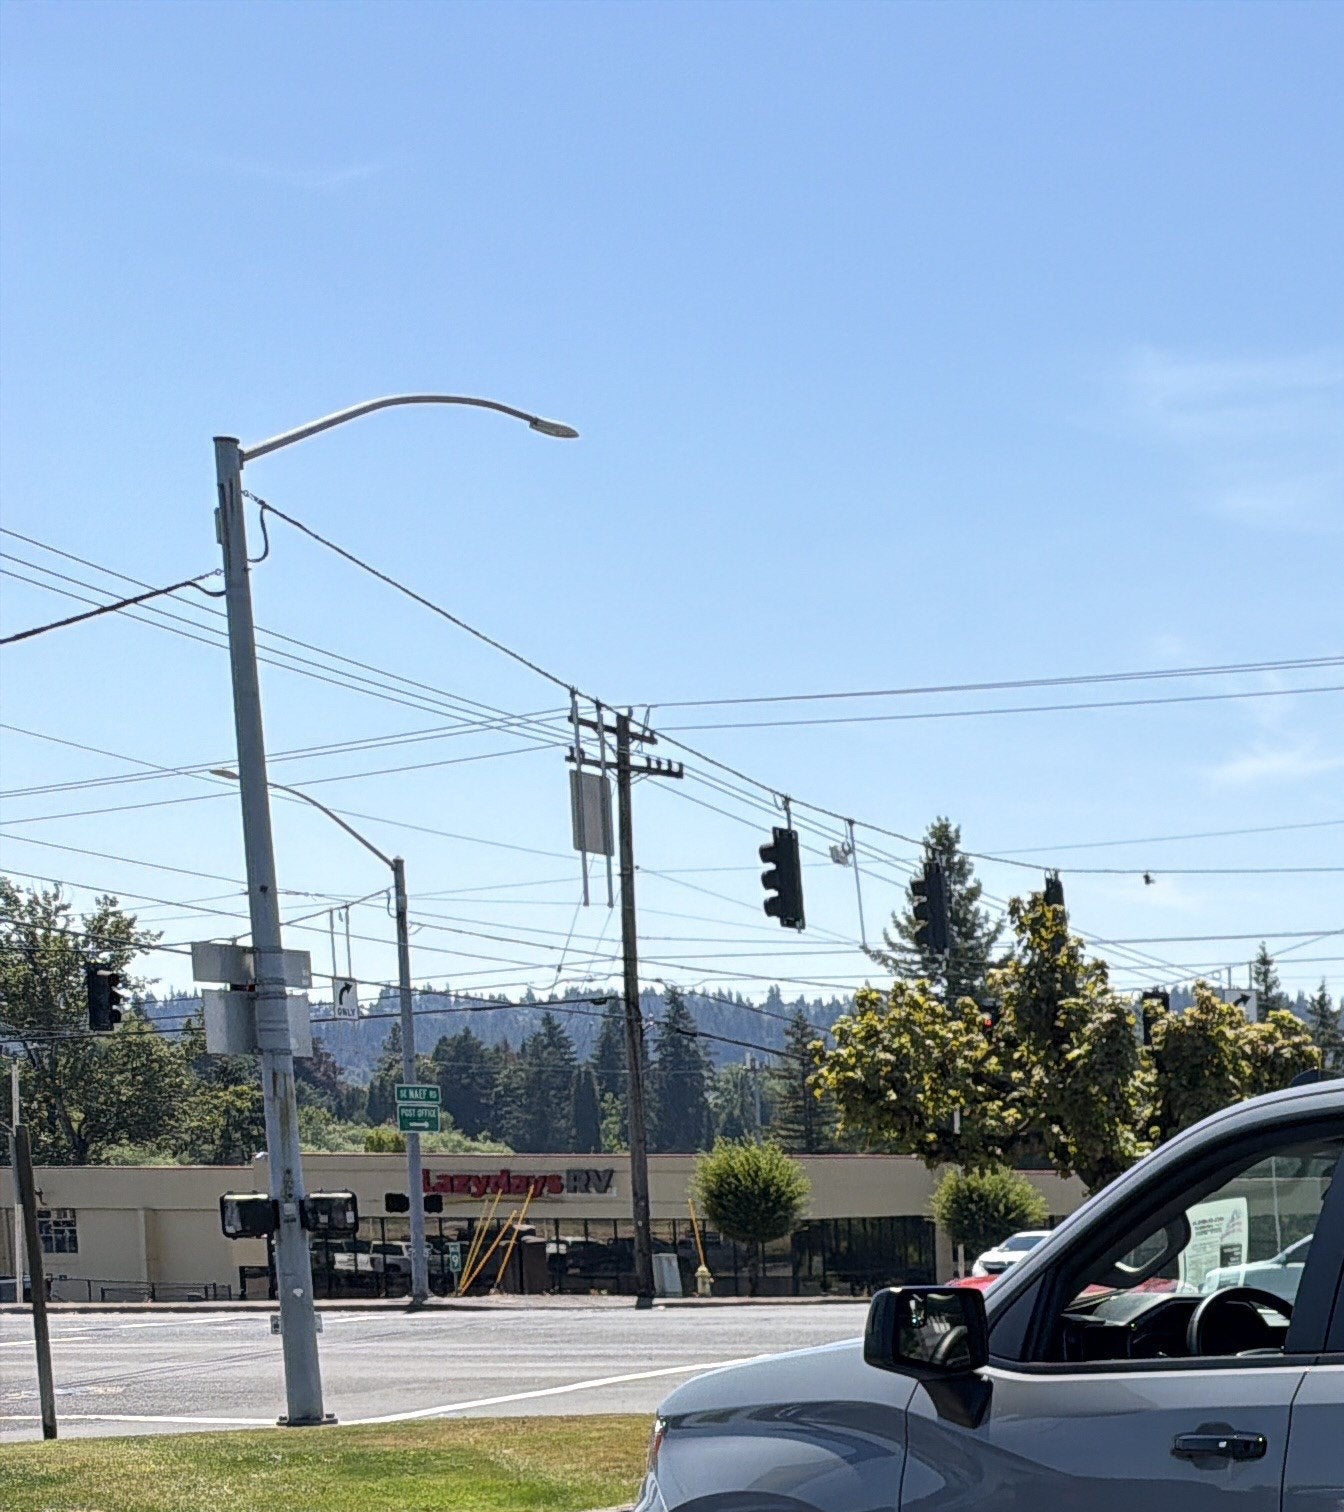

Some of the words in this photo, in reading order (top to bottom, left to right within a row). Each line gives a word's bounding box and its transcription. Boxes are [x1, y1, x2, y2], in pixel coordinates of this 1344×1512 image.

[337, 1007, 356, 1016] ONLY
[400, 1108, 416, 1118] POST
[416, 1108, 437, 1118] OFFICE
[422, 1168, 564, 1198] Lazydays
[565, 1168, 615, 1194] RV
